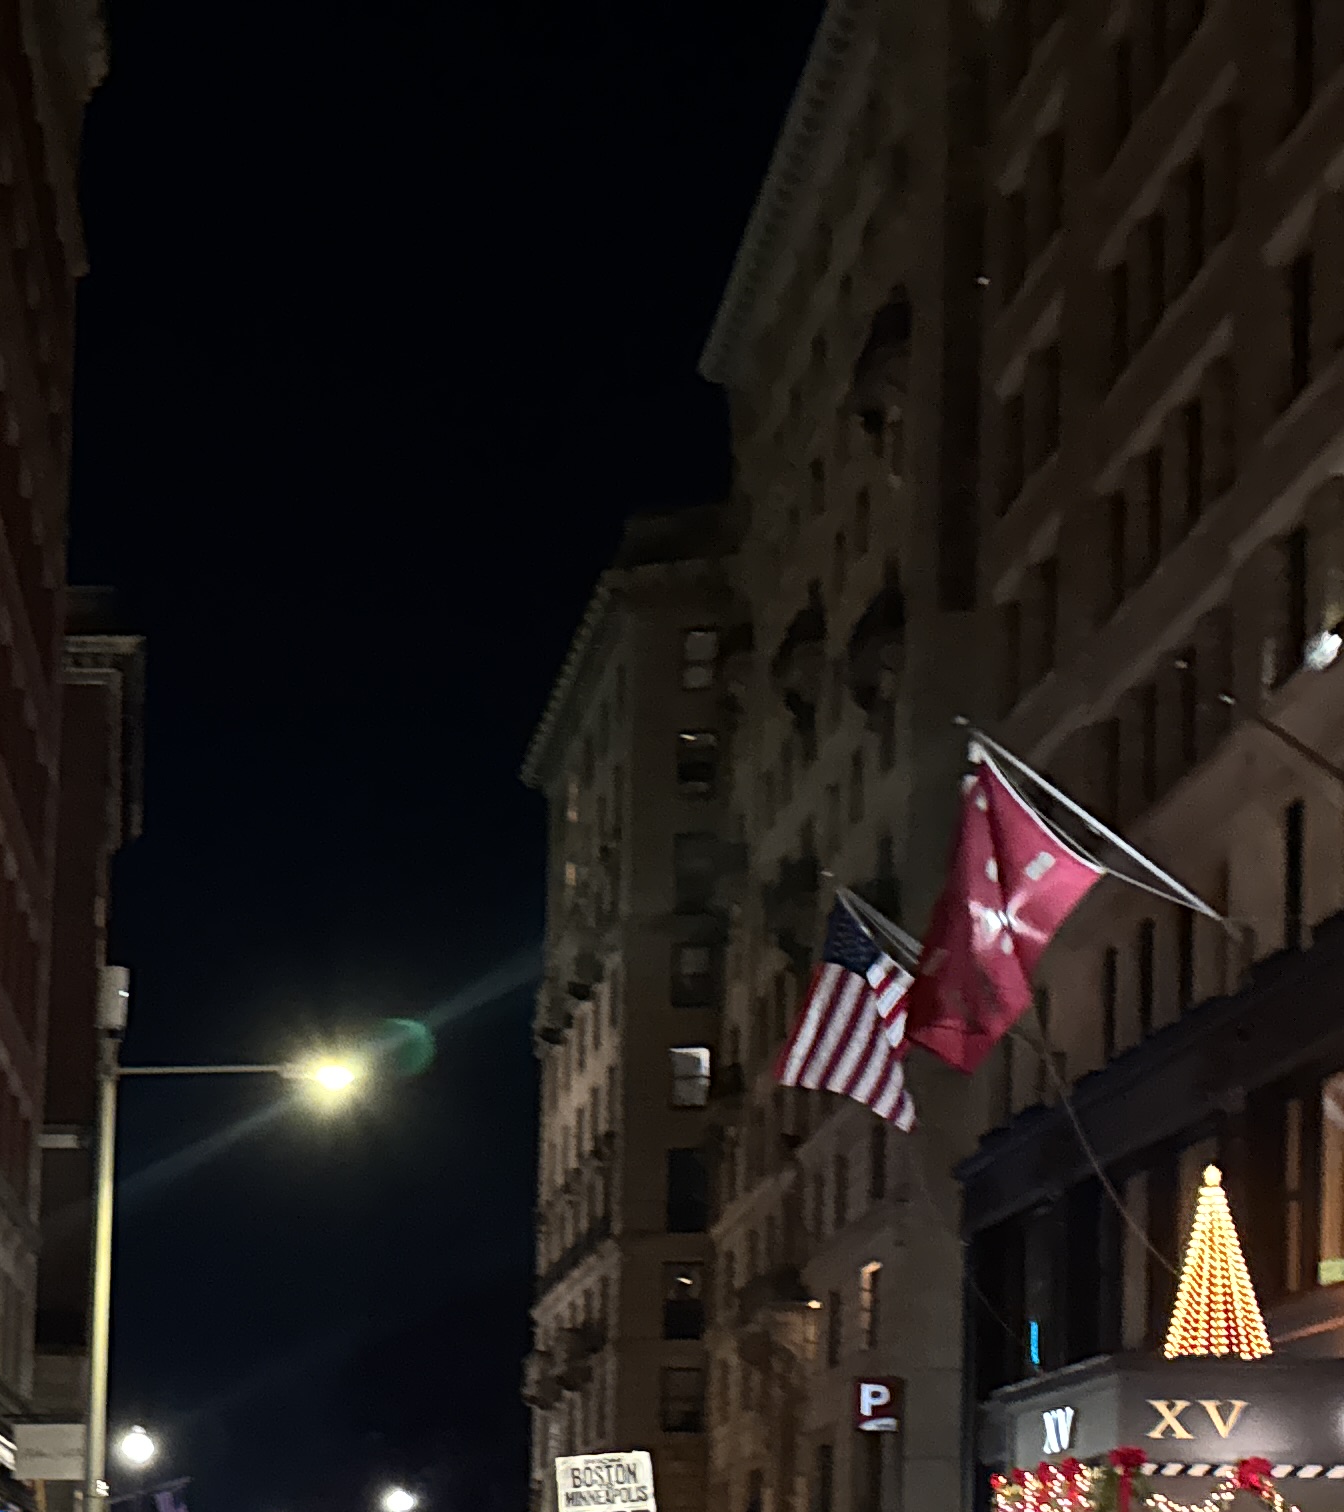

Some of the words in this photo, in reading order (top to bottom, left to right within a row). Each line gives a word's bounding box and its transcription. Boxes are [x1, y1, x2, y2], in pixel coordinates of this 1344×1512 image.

[860, 1383, 891, 1417] P
[1146, 1399, 1250, 1440] XV
[571, 1463, 638, 1489] BOSTON
